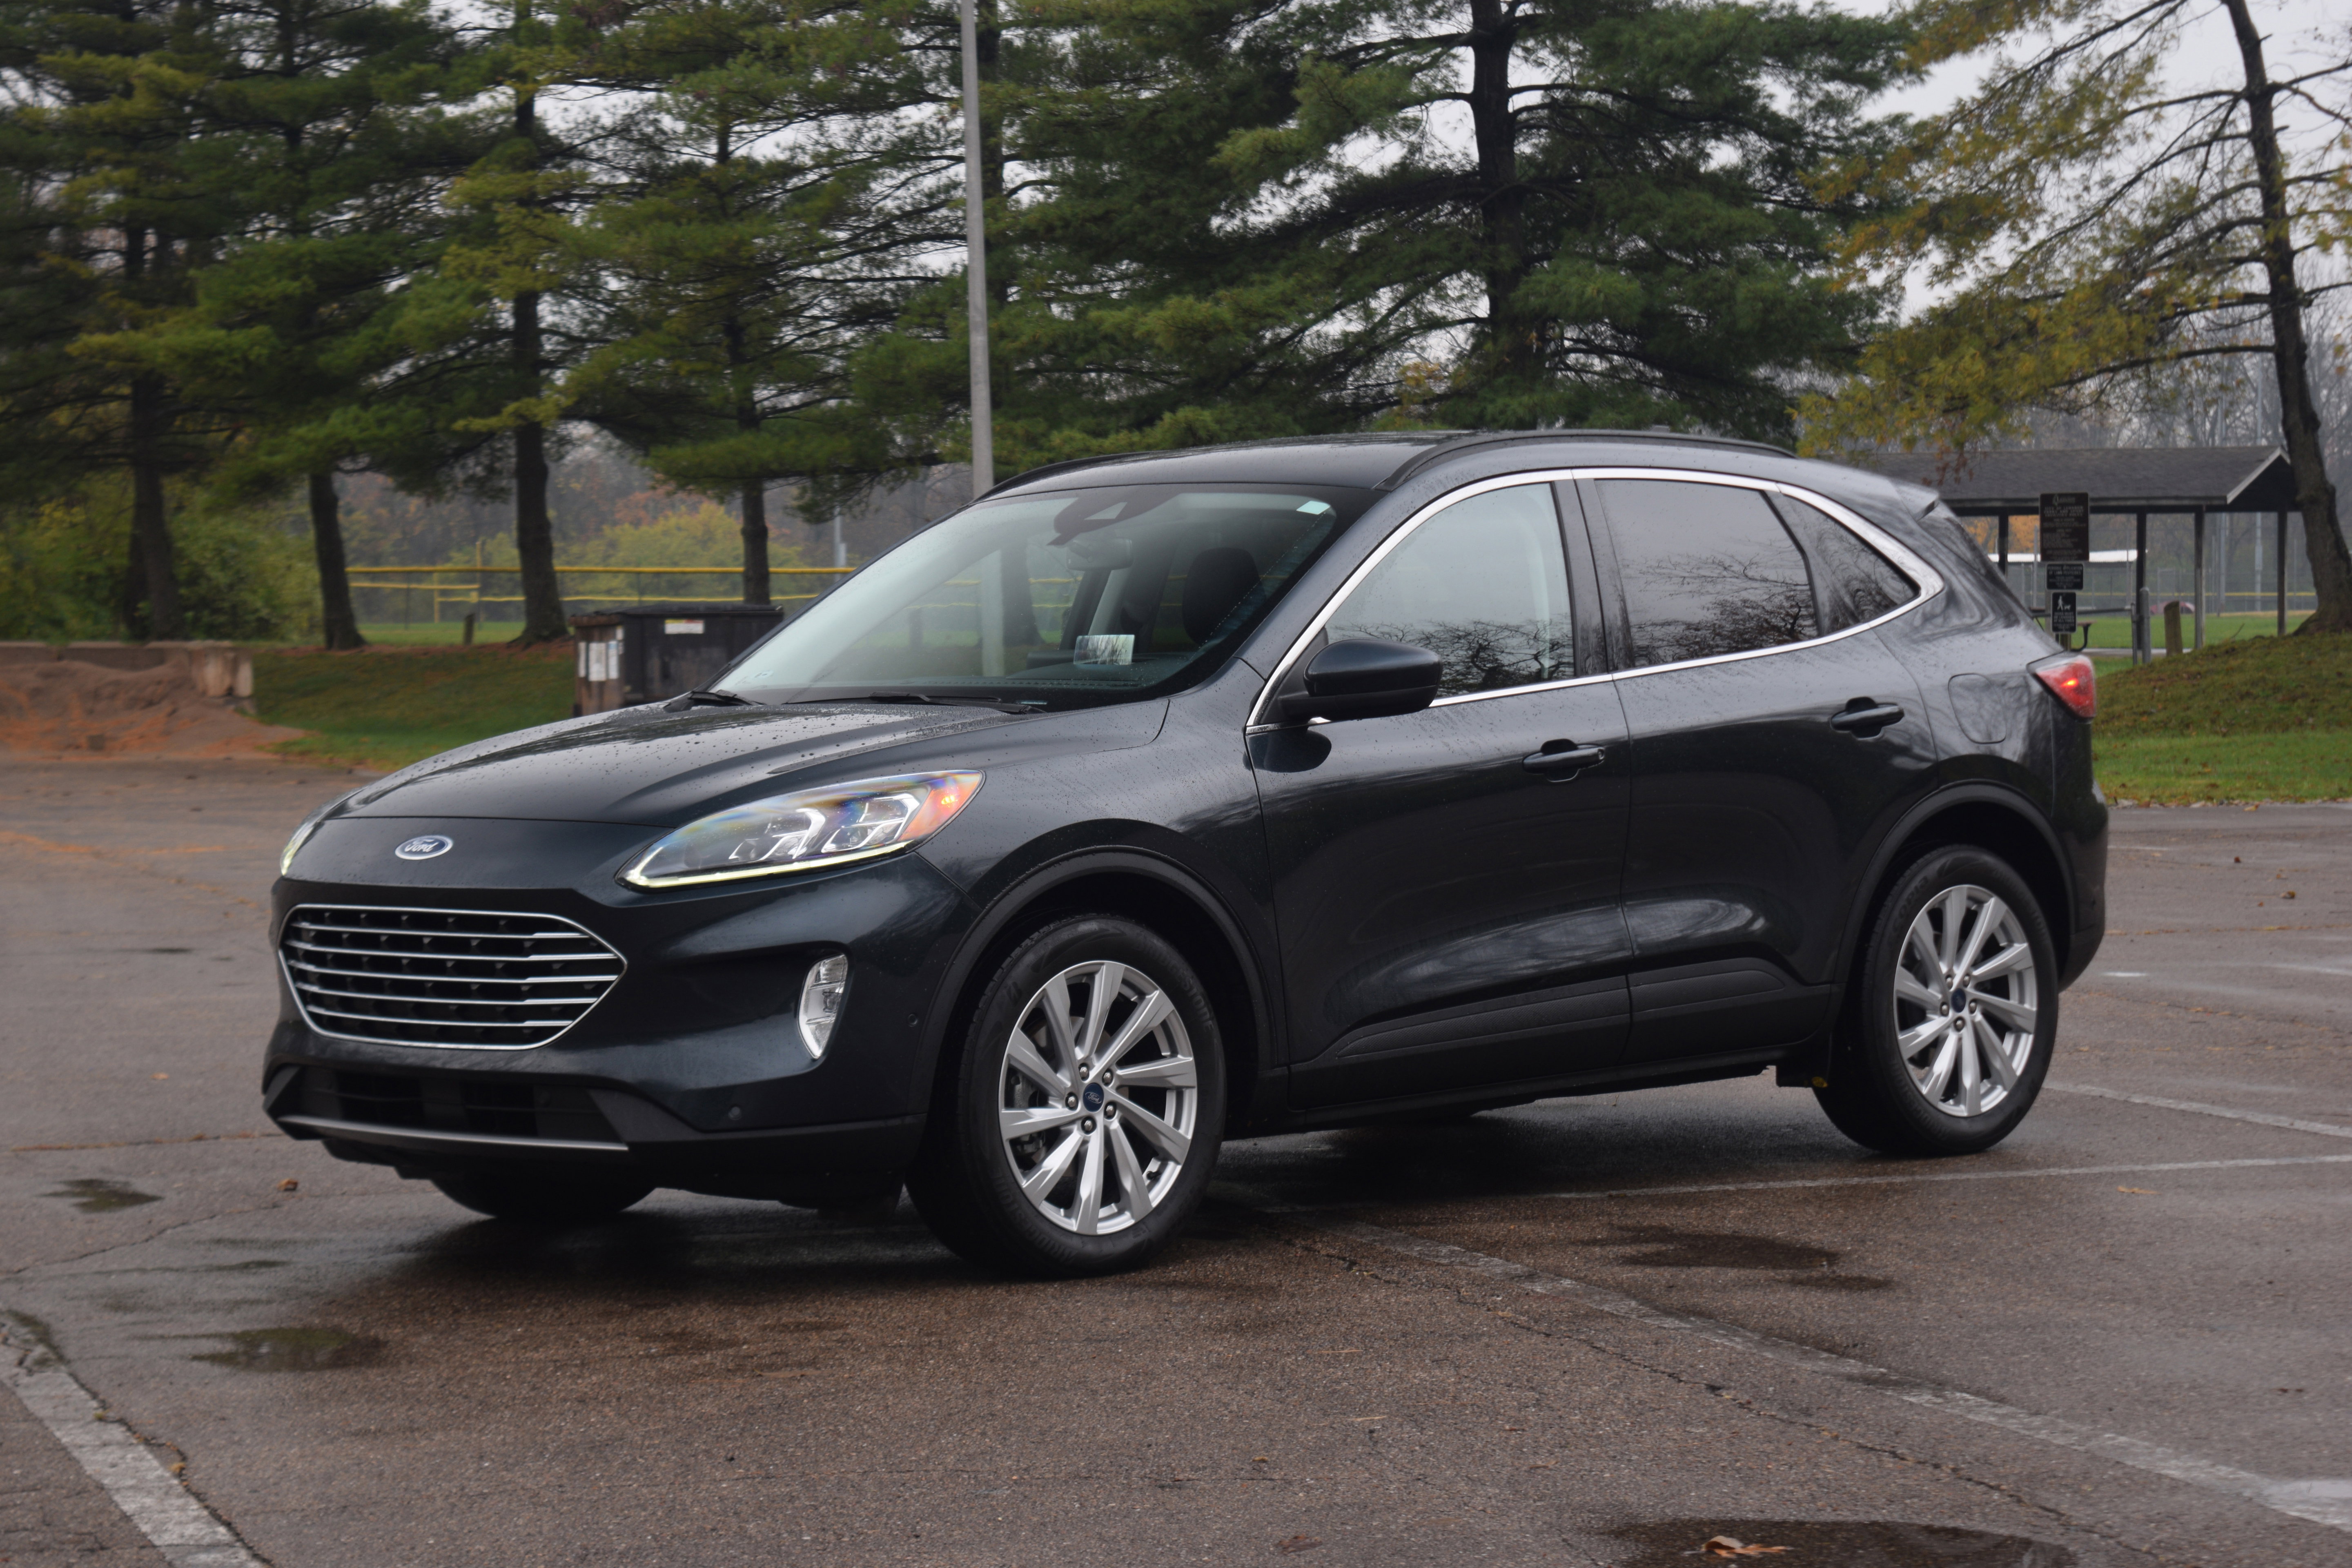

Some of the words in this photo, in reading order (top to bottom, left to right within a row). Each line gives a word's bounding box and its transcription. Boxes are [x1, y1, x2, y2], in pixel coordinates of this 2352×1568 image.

[404, 838, 439, 853] Ford
[1134, 932, 1214, 1033] BRIDGESTONE
[1088, 1093, 1100, 1102] Ford
[988, 1168, 1078, 1264] BRIDGESTONE
